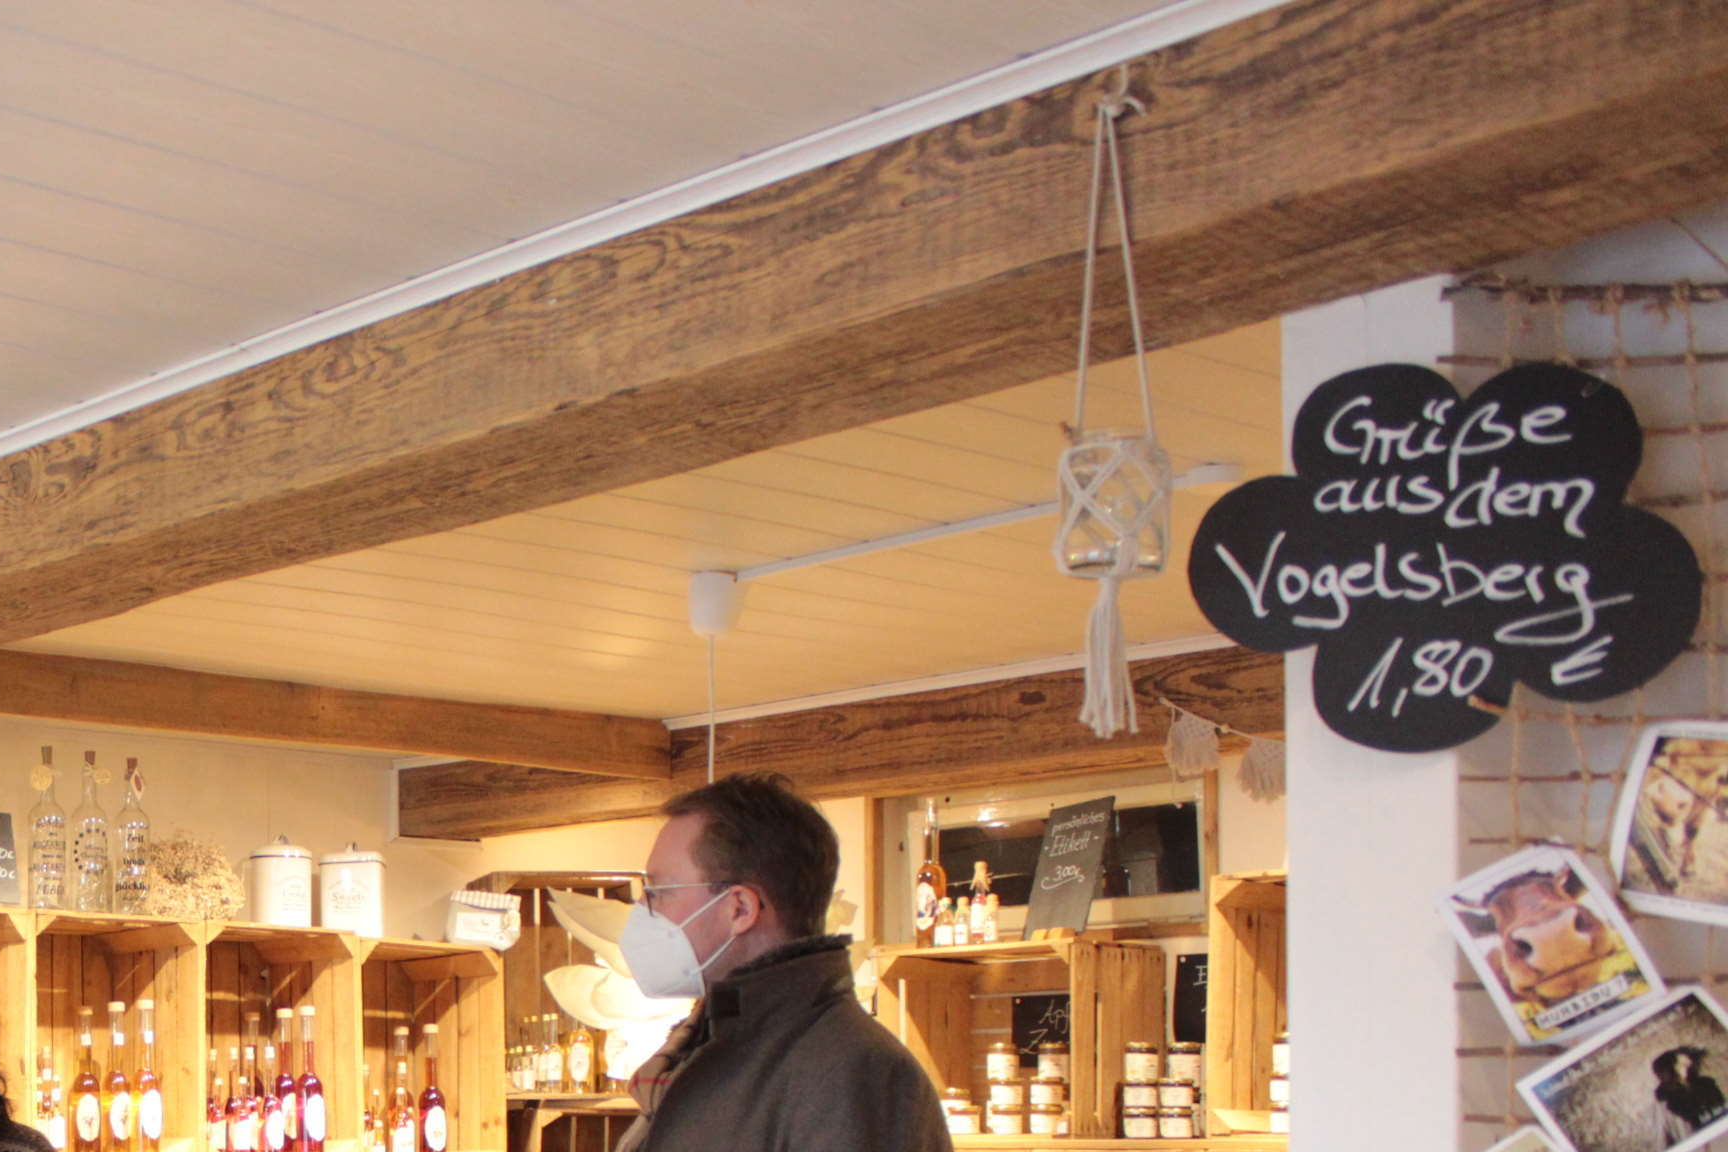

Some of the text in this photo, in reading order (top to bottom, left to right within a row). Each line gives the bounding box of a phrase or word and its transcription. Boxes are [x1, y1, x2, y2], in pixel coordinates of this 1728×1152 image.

[1324, 396, 1573, 490] Grüße
[1314, 467, 1595, 538] aus dem
[1215, 532, 1634, 646] Vogelsberg
[1348, 637, 1494, 718] 1,80
